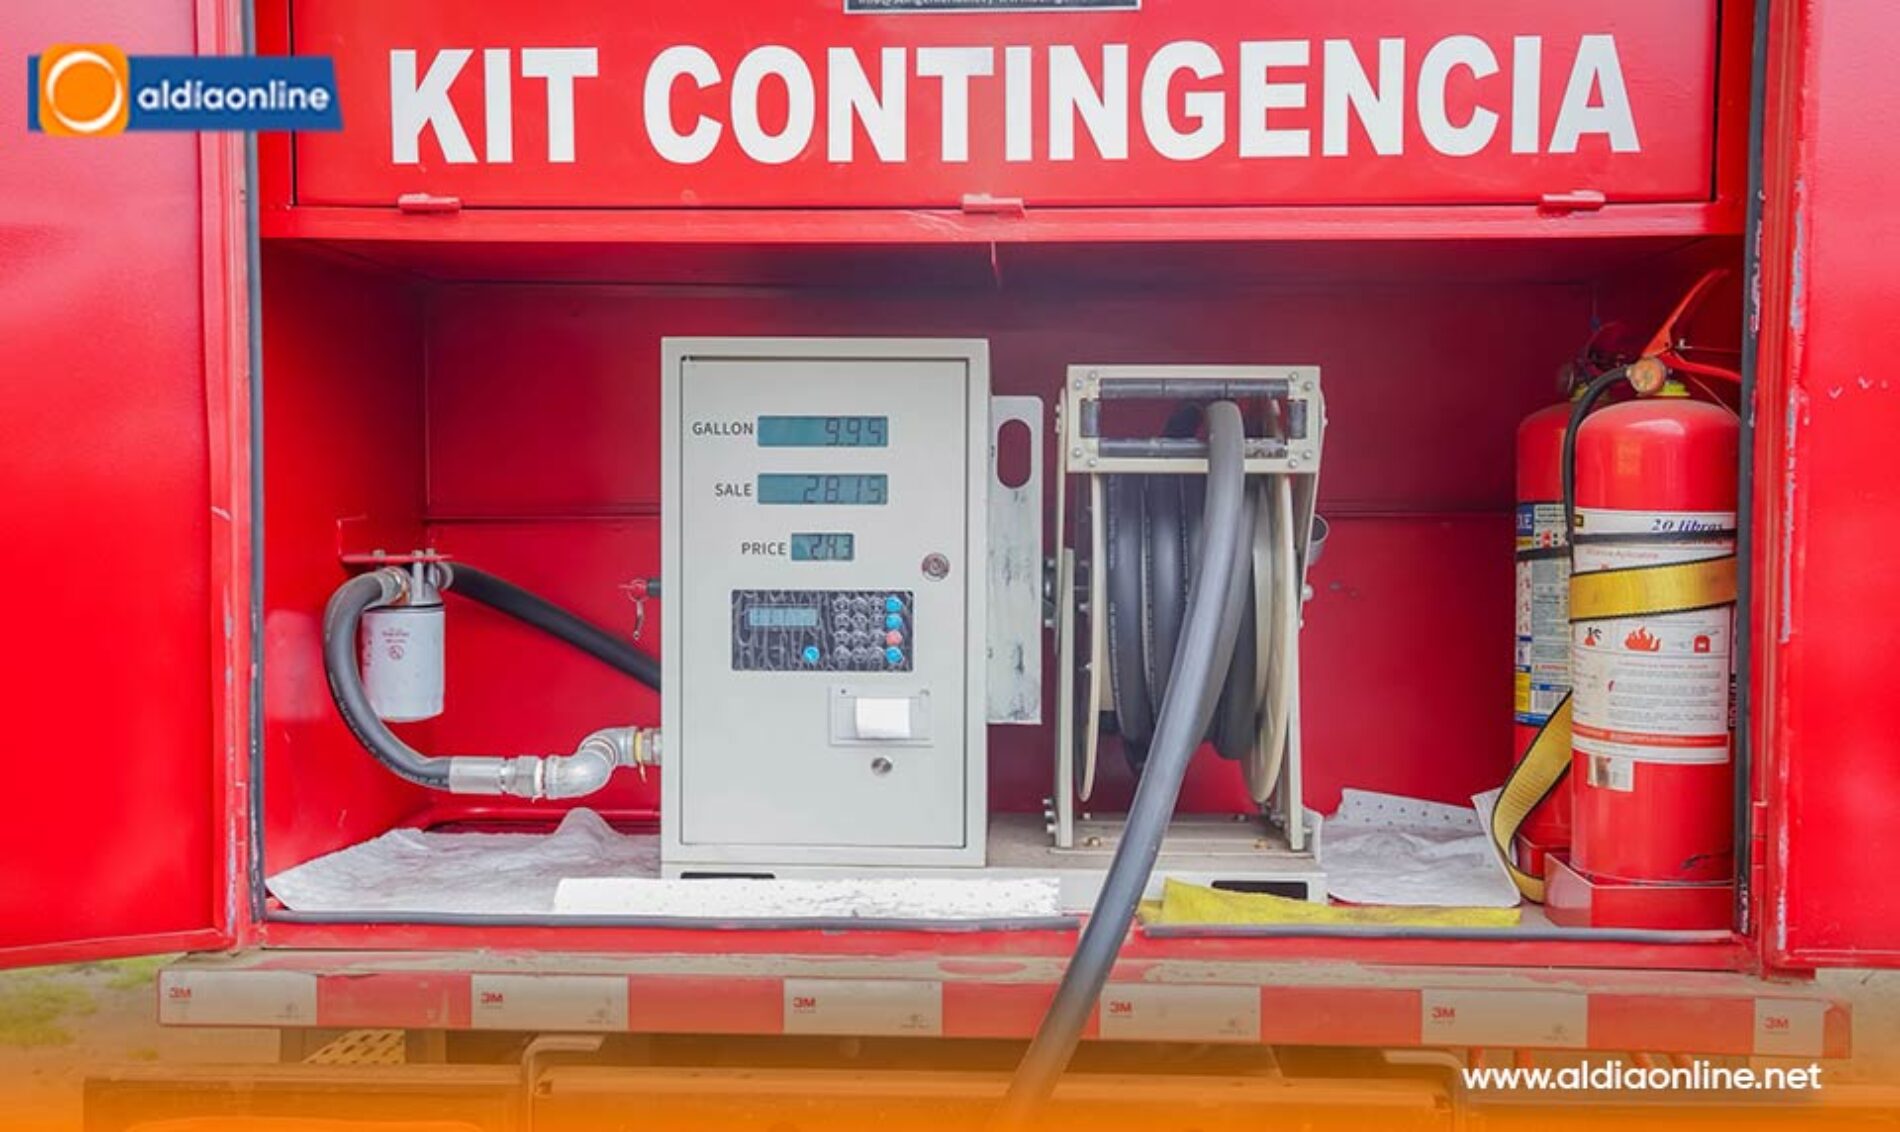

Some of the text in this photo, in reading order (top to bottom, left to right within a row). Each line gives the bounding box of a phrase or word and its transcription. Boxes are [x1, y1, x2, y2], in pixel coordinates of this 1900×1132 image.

[390, 34, 1641, 165] KIT CONTINGENCIA
[692, 421, 754, 436] GALLON
[714, 483, 752, 497] SALE
[1651, 518, 1674, 531] 20
[741, 541, 786, 556] PRICE
[479, 992, 504, 1004] 3M
[792, 996, 817, 1008] 3M
[1109, 1001, 1132, 1013] 3M
[1431, 1006, 1456, 1018] 3M
[1764, 1017, 1790, 1029] 3M
